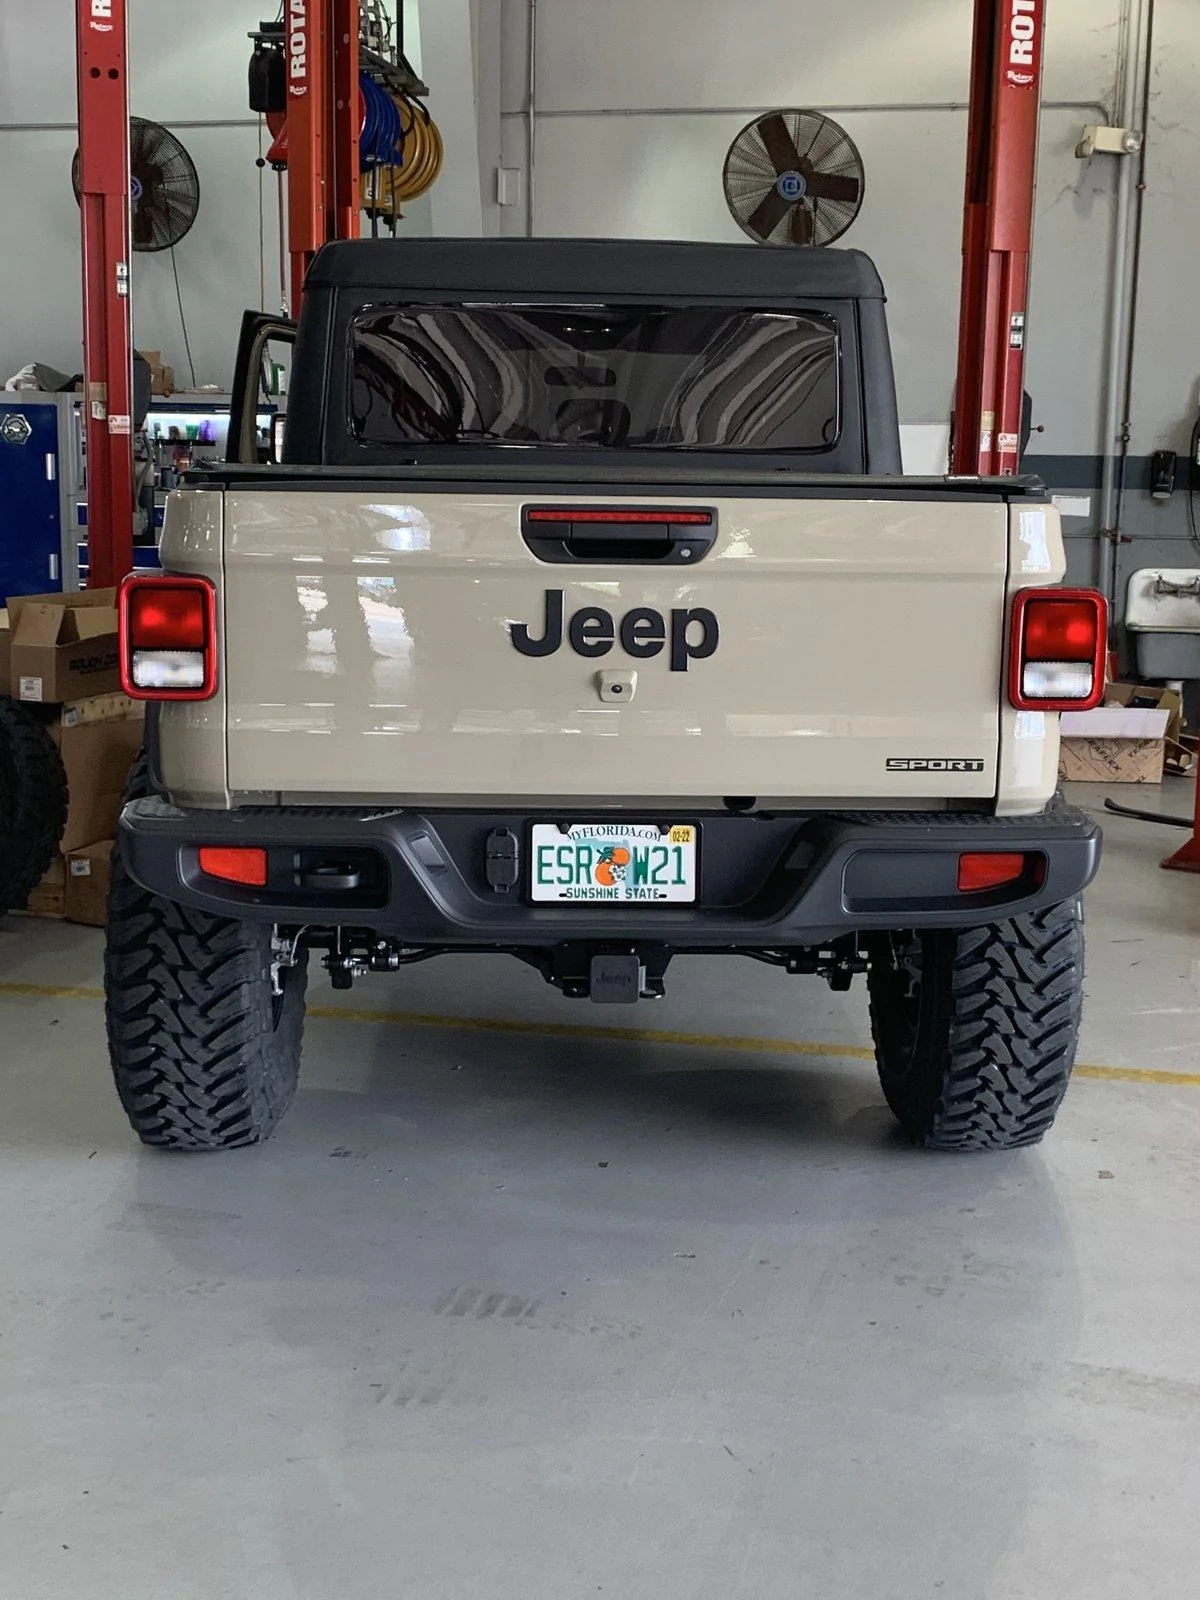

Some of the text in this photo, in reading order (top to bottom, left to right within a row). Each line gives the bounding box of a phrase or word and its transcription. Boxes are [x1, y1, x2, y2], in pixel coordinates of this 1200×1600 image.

[511, 589, 719, 671] Jeep
[886, 759, 984, 770] SPORT
[567, 825, 662, 842] MYFLORIDA.COM
[672, 830, 690, 842] 02-22
[537, 845, 686, 885] ESR W21
[566, 887, 660, 899] SUNSHINE STATE
